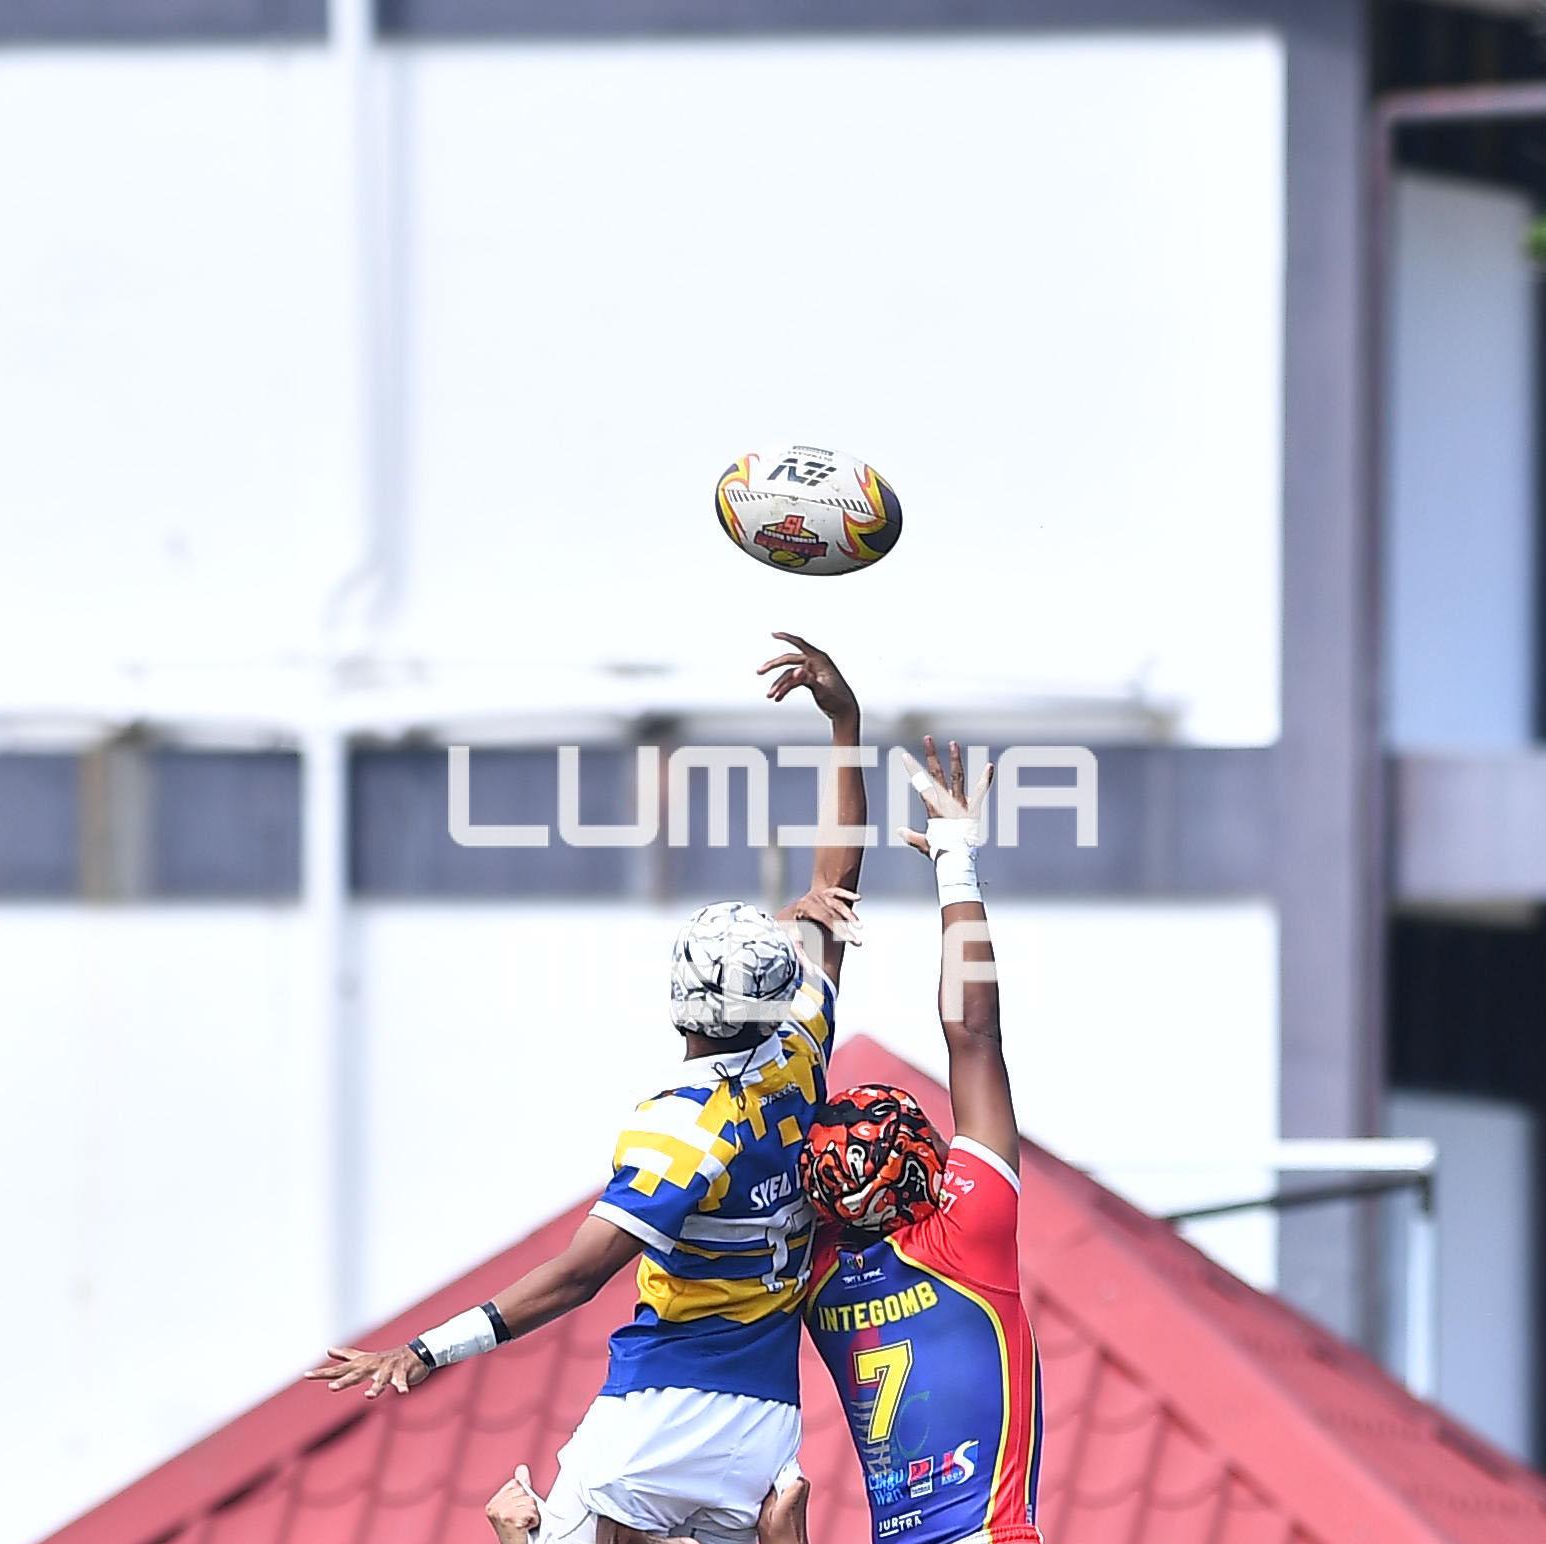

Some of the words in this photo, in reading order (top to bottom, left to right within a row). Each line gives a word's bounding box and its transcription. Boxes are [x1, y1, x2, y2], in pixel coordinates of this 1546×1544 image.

[750, 1170, 792, 1211] SYED
[818, 1281, 939, 1333] INTEGOMB
[853, 1339, 913, 1444] 7
